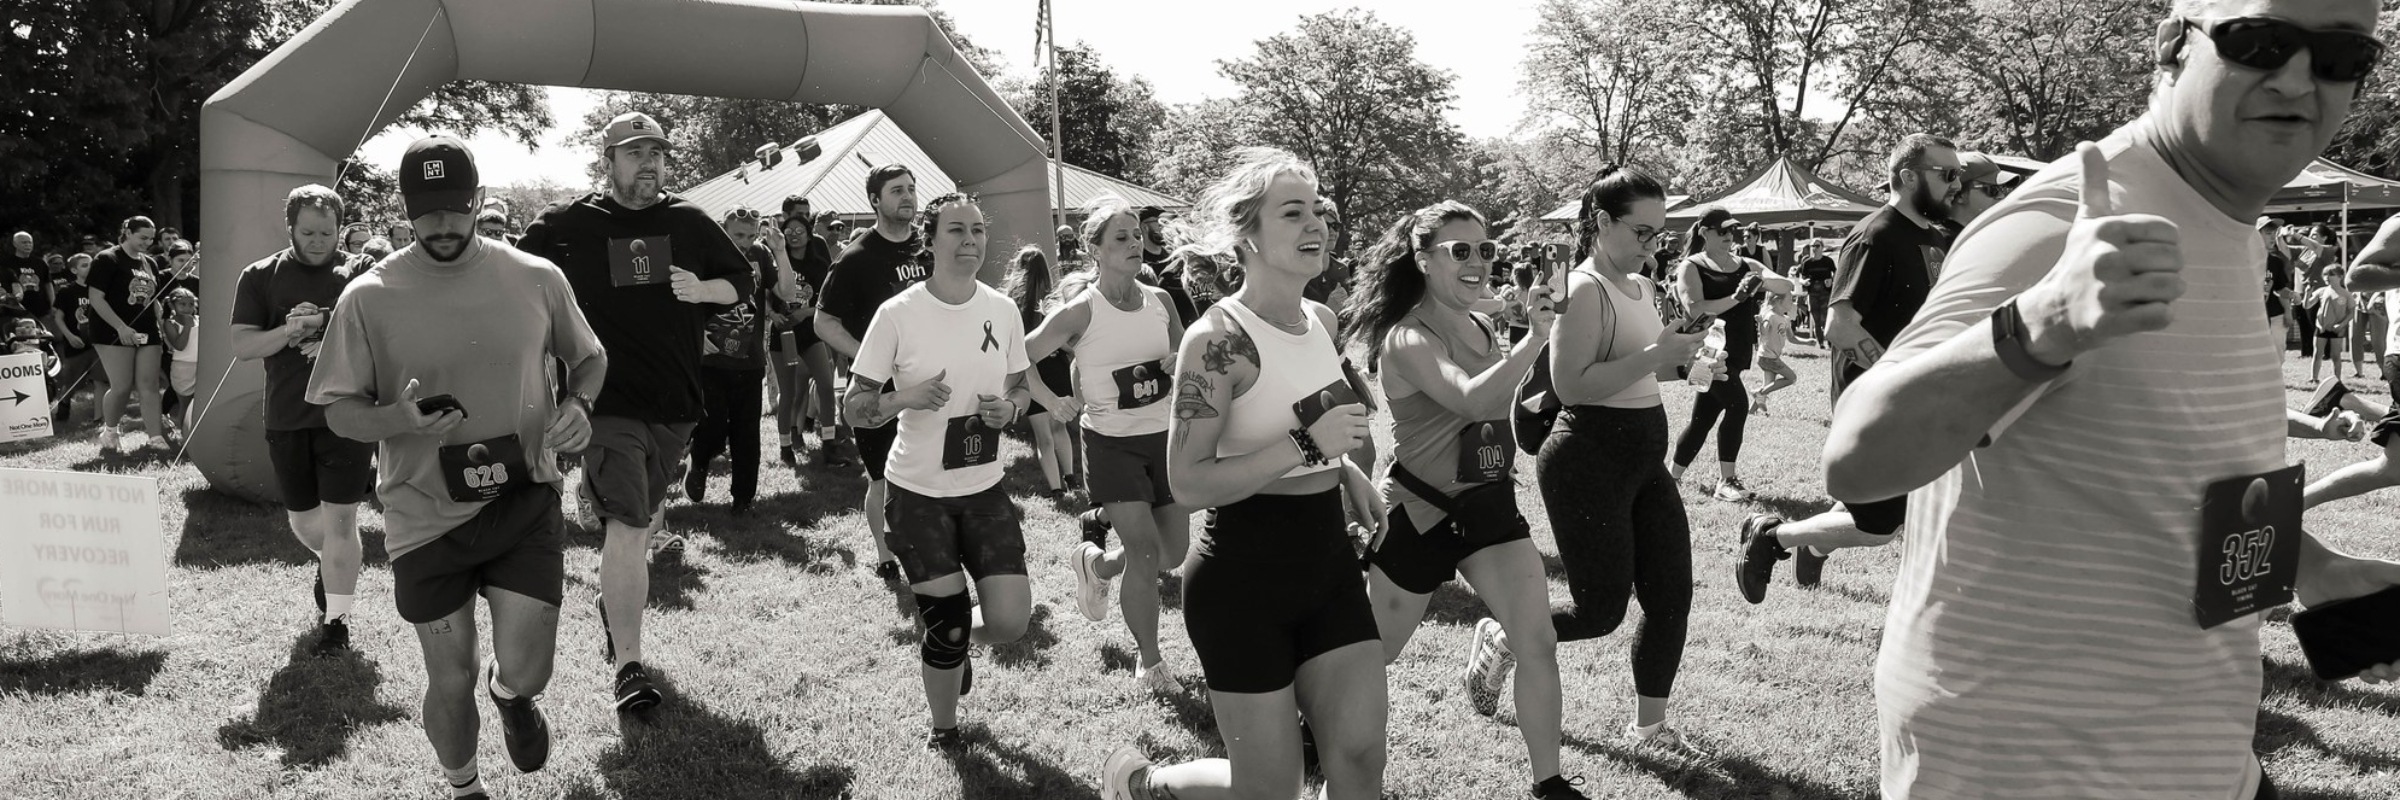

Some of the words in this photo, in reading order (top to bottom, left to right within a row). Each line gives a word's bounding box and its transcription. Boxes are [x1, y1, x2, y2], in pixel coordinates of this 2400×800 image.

[632, 256, 650, 274] 11
[895, 264, 926, 281] 10th
[0, 364, 42, 379] OOMS
[963, 434, 982, 456] 16
[1477, 444, 1504, 469] 104
[463, 462, 509, 489] 628
[2220, 525, 2276, 585] 352
